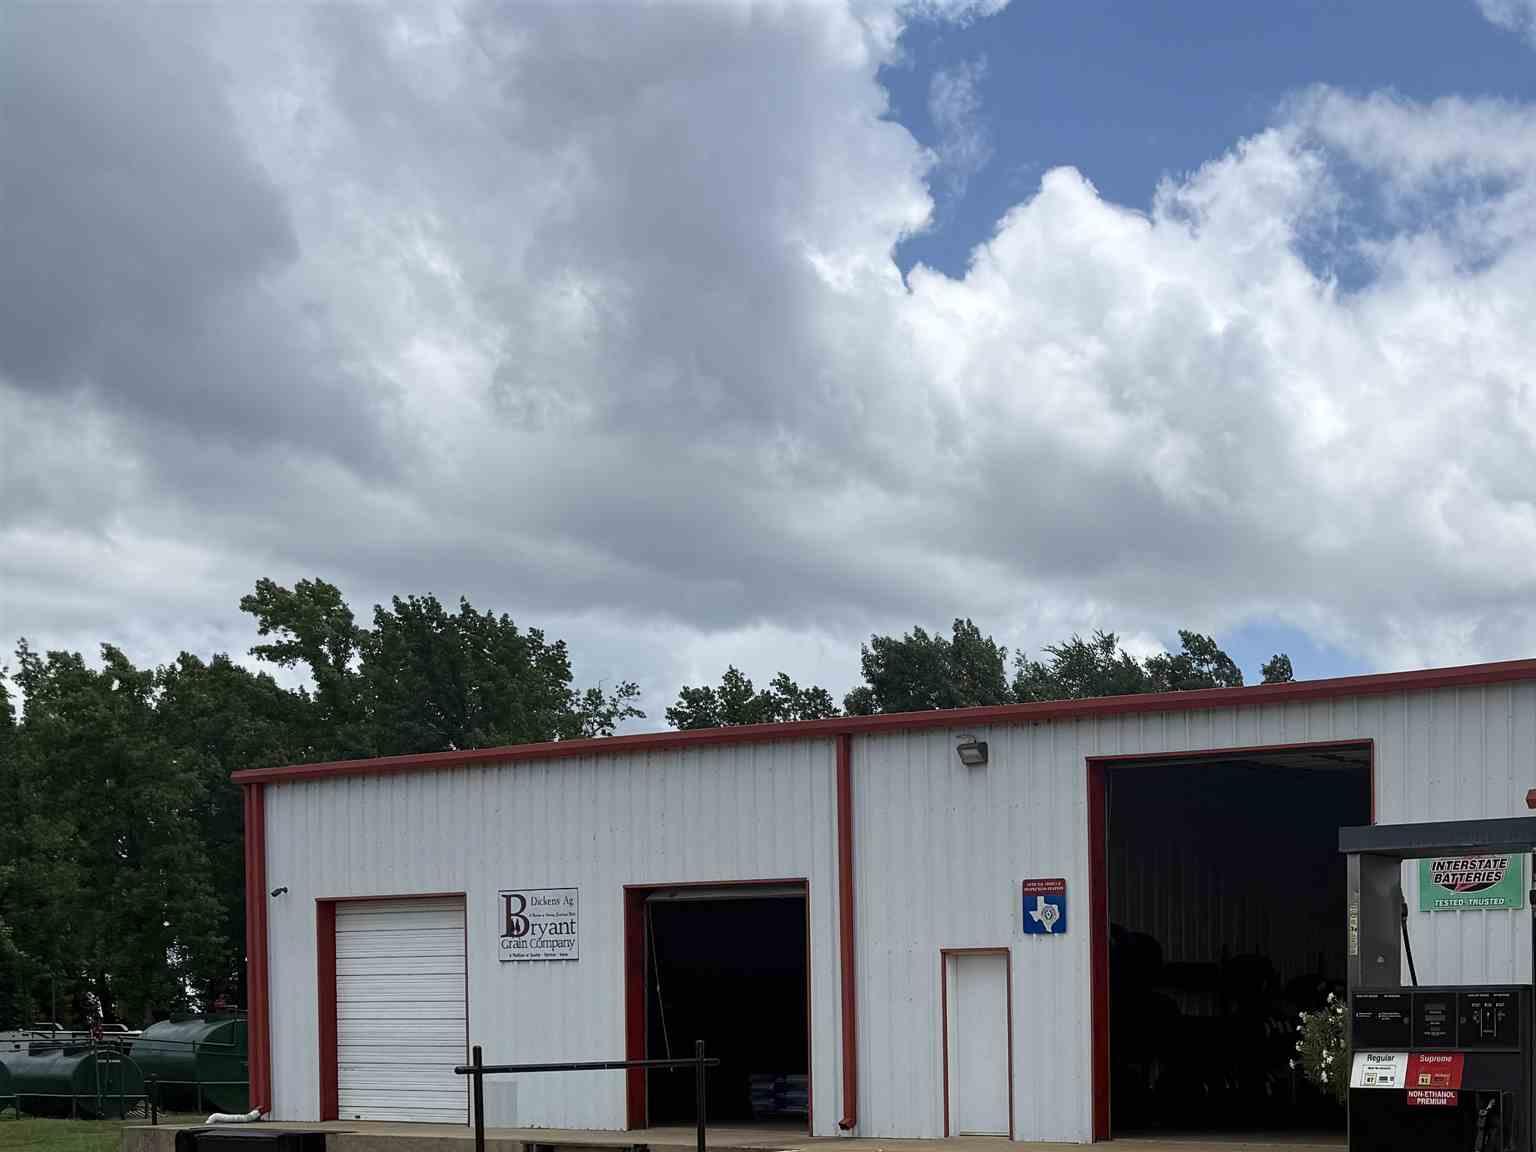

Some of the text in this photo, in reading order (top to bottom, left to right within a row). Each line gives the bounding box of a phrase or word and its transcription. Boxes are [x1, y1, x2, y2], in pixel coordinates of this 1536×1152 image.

[1431, 858, 1508, 871] INTERSTATE
[1433, 871, 1502, 884] BATTERIES
[530, 895, 574, 906] Dickens Ag
[1434, 898, 1505, 907] TESTED TRUSTED
[500, 893, 577, 940] Bryant
[500, 938, 576, 951] Grain Company
[1367, 1054, 1395, 1064] Regular
[1419, 1054, 1453, 1064] Supreme
